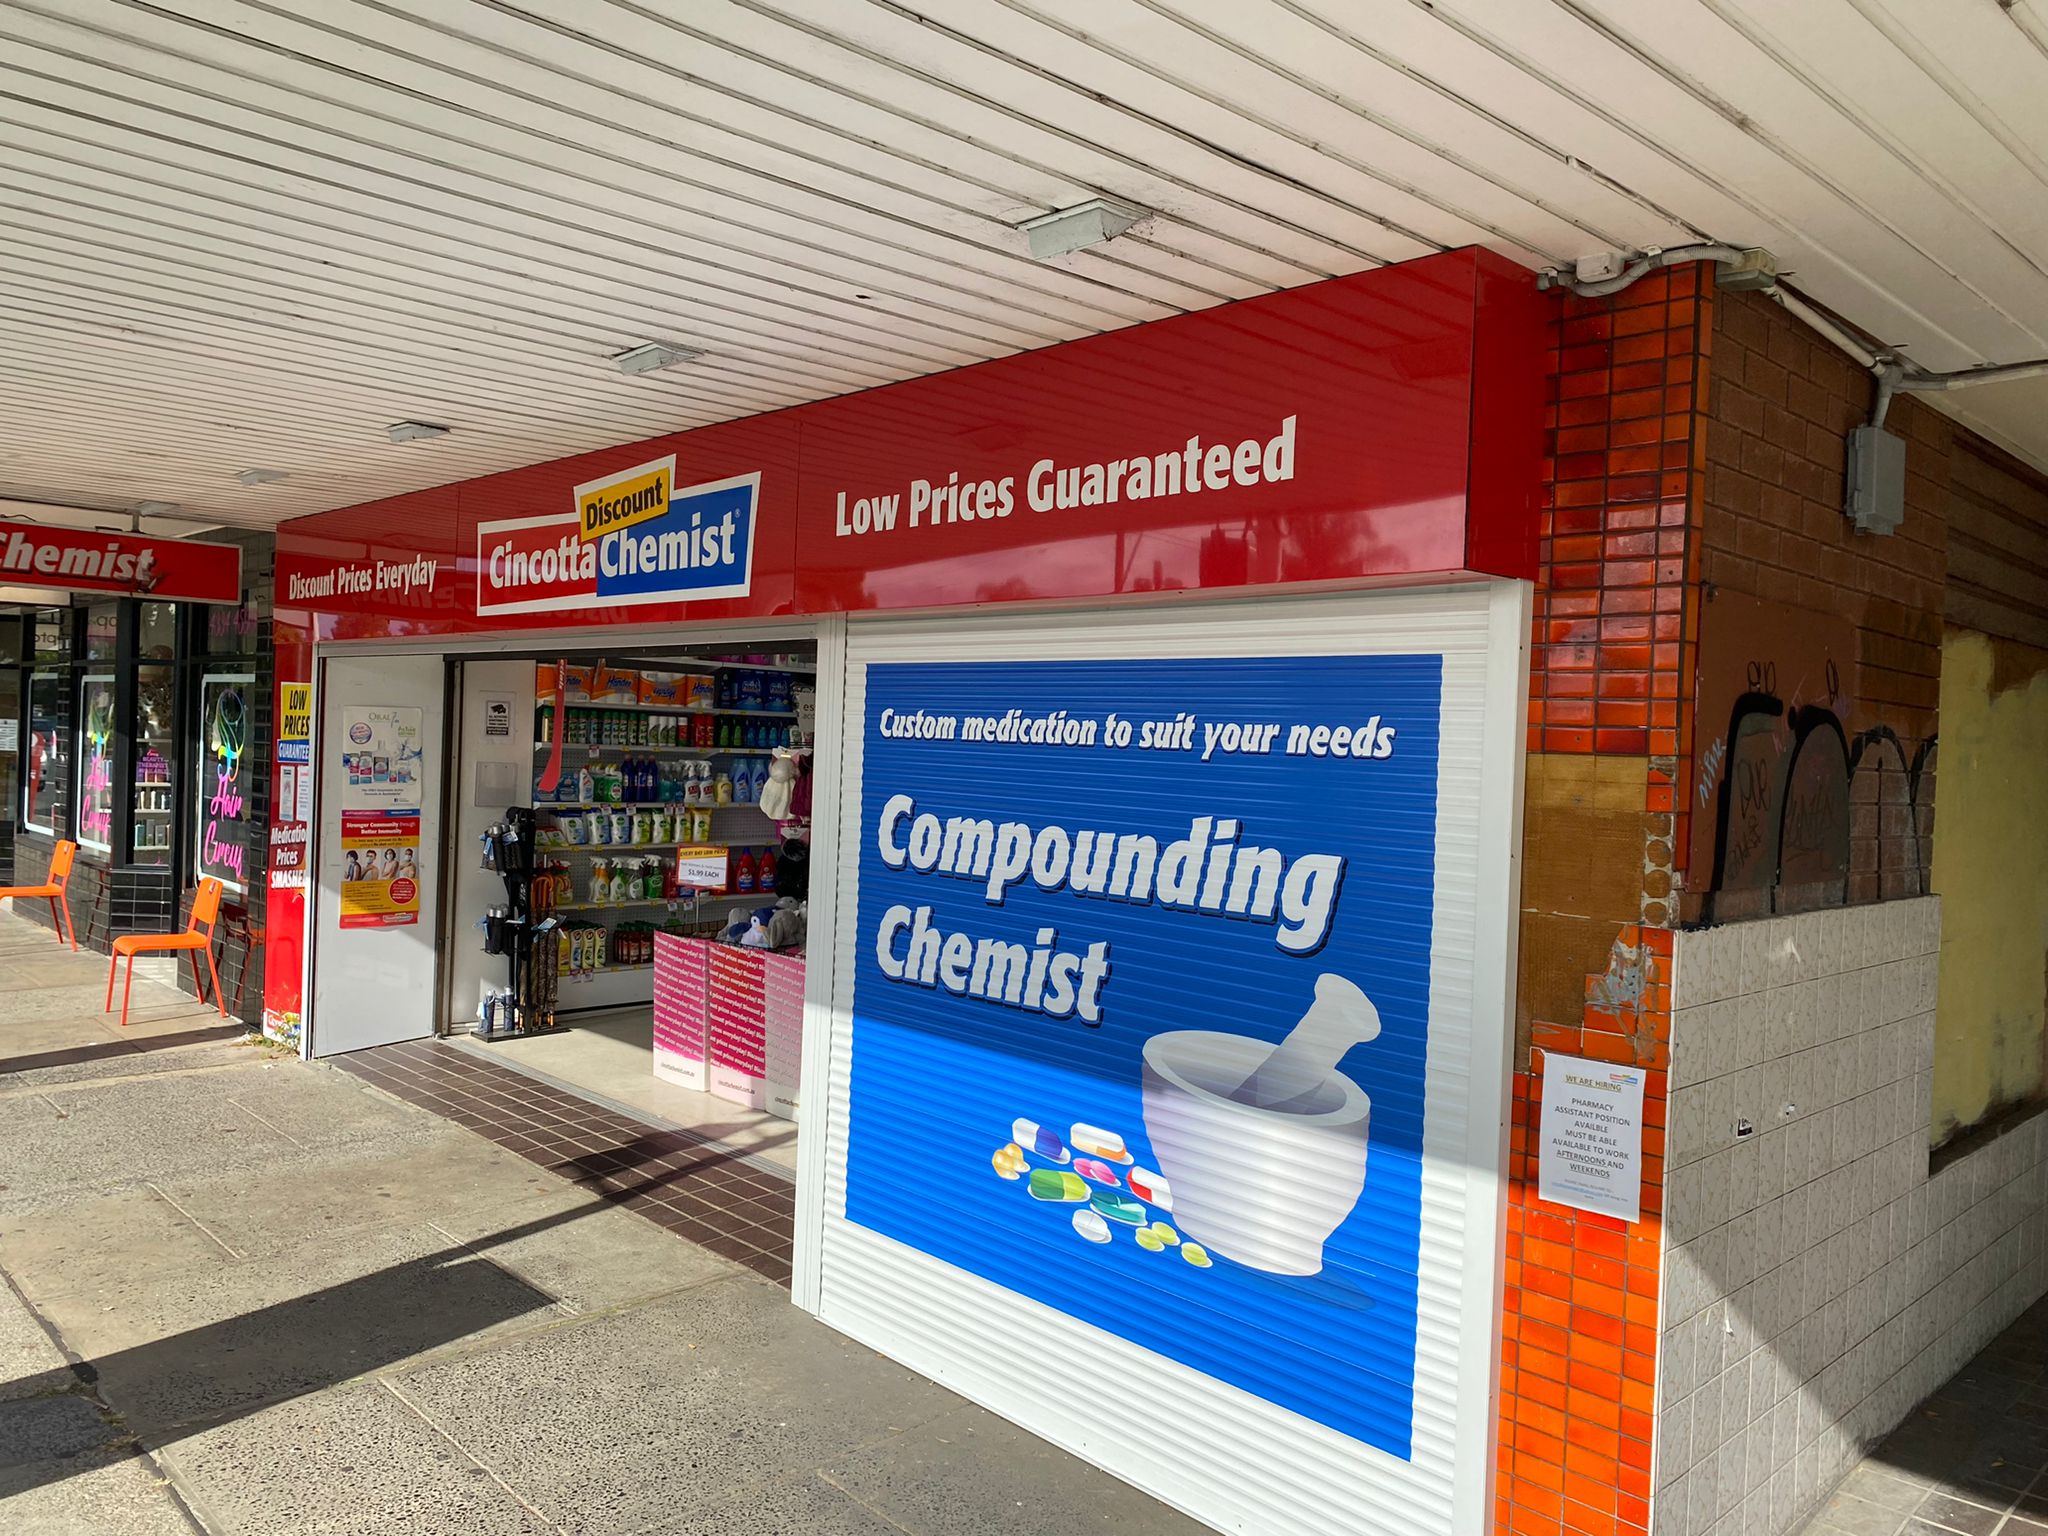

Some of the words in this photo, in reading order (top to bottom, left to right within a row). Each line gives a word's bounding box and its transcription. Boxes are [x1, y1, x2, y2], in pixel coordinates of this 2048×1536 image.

[835, 491, 900, 537] Low
[909, 471, 1014, 528] Prices
[1026, 414, 1297, 513] Guaranteed
[586, 476, 663, 531] Discount
[489, 534, 597, 589] Cincotta
[600, 511, 736, 578] Chemist
[289, 569, 335, 600] Discount
[337, 564, 373, 594] Prices
[376, 553, 437, 596] Everyday
[289, 689, 307, 711] LOW
[283, 714, 310, 736] PRICES
[879, 707, 955, 740] Custom
[961, 709, 1098, 747] medication
[1103, 712, 1131, 748] to
[1138, 712, 1196, 751] suit
[1200, 720, 1277, 761] your
[1285, 715, 1396, 760] needs
[210, 772, 243, 822] Hair
[370, 821, 399, 829] Community
[276, 847, 298, 866] Prices
[688, 869, 704, 877] $1.99
[704, 870, 720, 878] EACH
[877, 794, 1345, 956] Compounding
[875, 903, 1110, 1025] Chemist
[1565, 1074, 1577, 1085] WE
[1579, 1077, 1594, 1088] ARE
[1595, 1079, 1622, 1092] HIRING
[1571, 1098, 1614, 1112] PHARMACY
[1555, 1106, 1593, 1120] ASSISTANT
[1595, 1113, 1630, 1127] POSITION
[1574, 1120, 1608, 1133] AVAILBLE
[1565, 1129, 1586, 1140] MUST
[1588, 1134, 1597, 1142] BE
[1599, 1136, 1617, 1146] ABLE
[1552, 1138, 1591, 1152] AVAILABLE
[1593, 1145, 1604, 1154] TO
[1605, 1149, 1630, 1160] WORK
[1556, 1150, 1606, 1166] AFTERNOONS
[1606, 1160, 1624, 1170] AND
[1570, 1163, 1610, 1178] WEEKENDS
